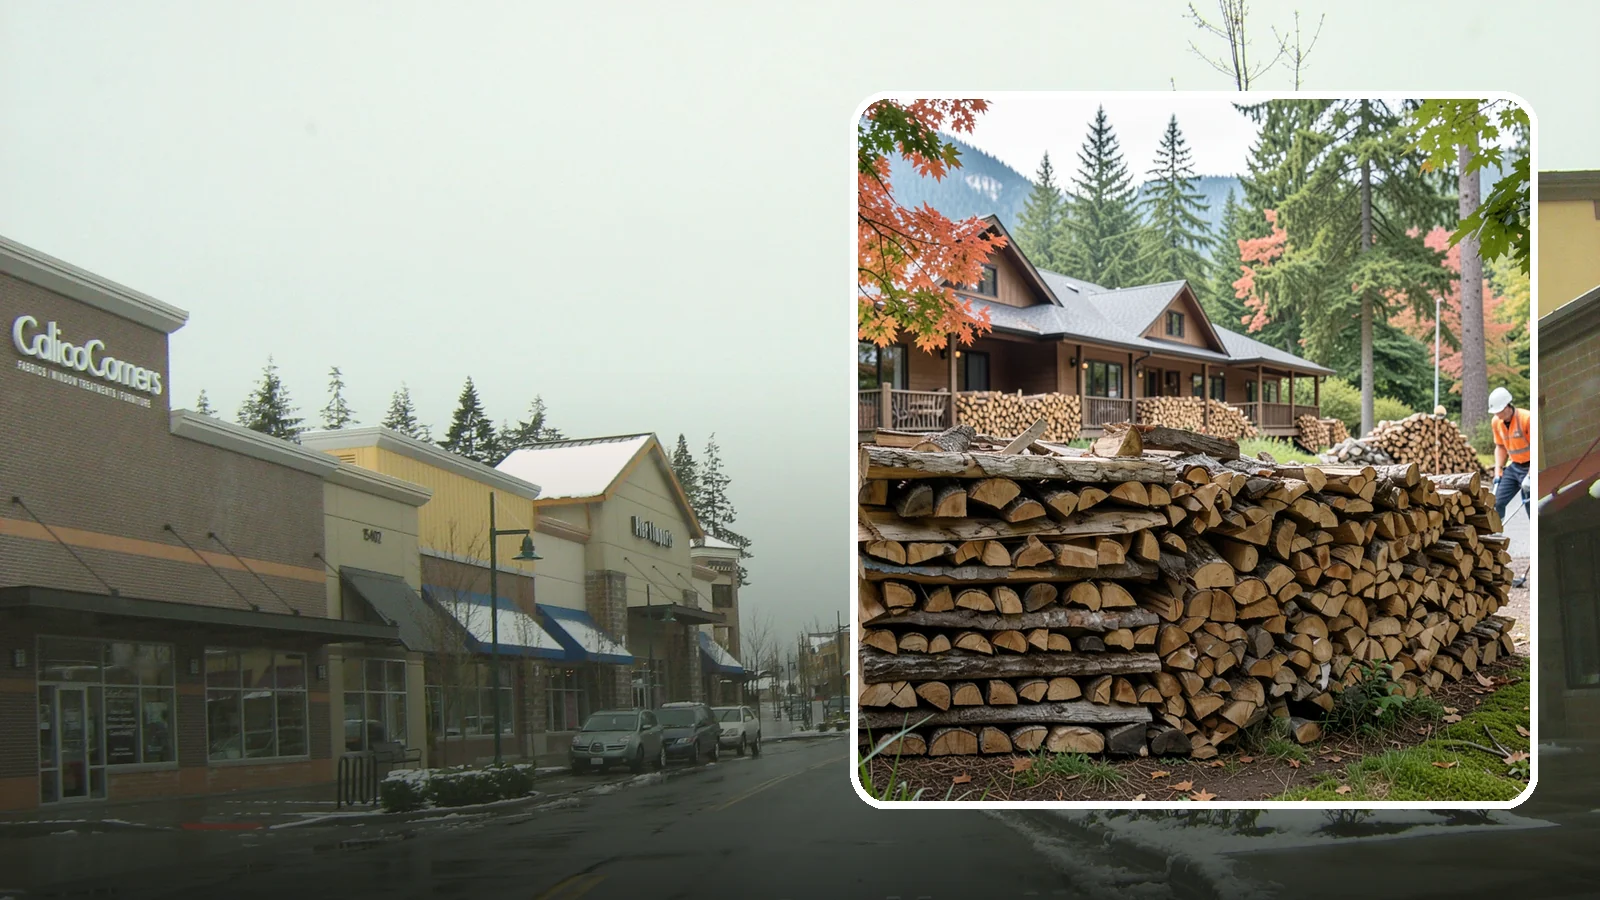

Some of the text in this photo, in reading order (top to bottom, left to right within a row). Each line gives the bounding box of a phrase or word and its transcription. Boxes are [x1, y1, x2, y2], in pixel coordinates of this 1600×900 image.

[12, 315, 162, 395] CalicoCorners
[16, 360, 151, 409] FABRICS WINDOW TREATMENTS FURNITURE
